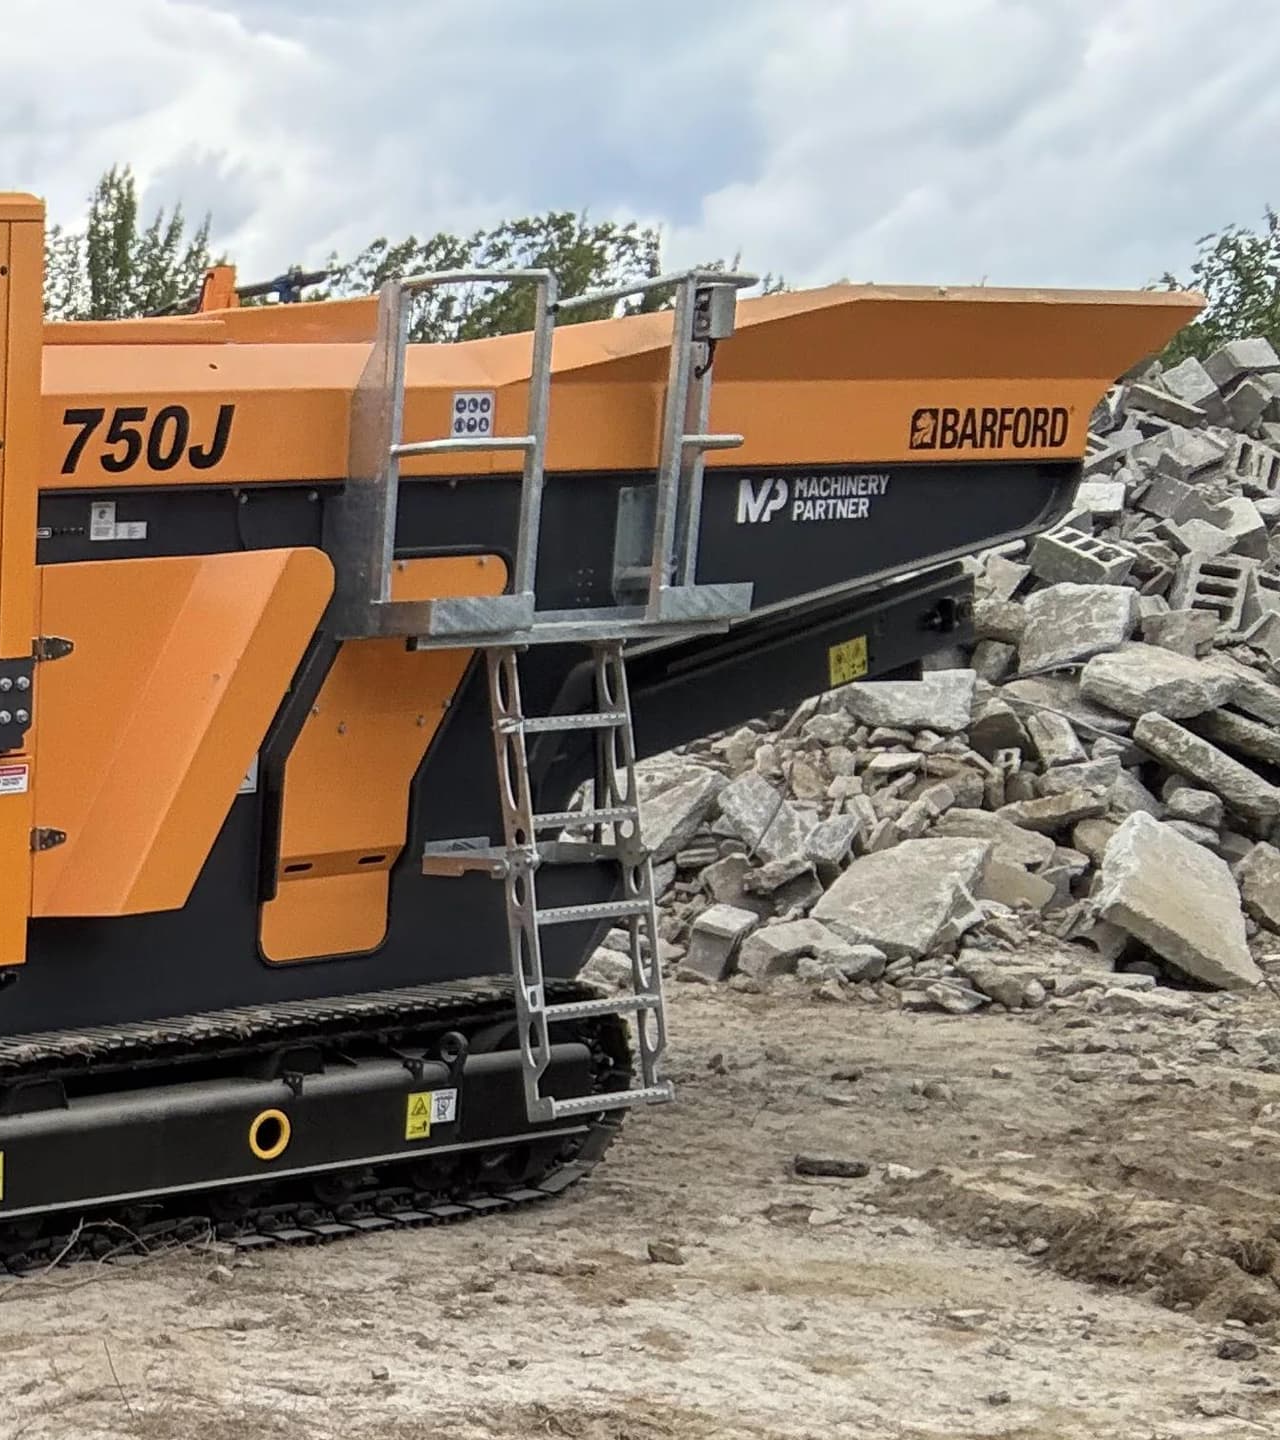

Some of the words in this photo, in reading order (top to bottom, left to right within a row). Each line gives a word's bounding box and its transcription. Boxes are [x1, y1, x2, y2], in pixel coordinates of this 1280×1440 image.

[61, 405, 236, 474] 750J
[939, 407, 1069, 449] BARFORD
[736, 478, 788, 524] MP
[795, 475, 890, 498] MACHINERY
[792, 498, 869, 521] PARTNER
